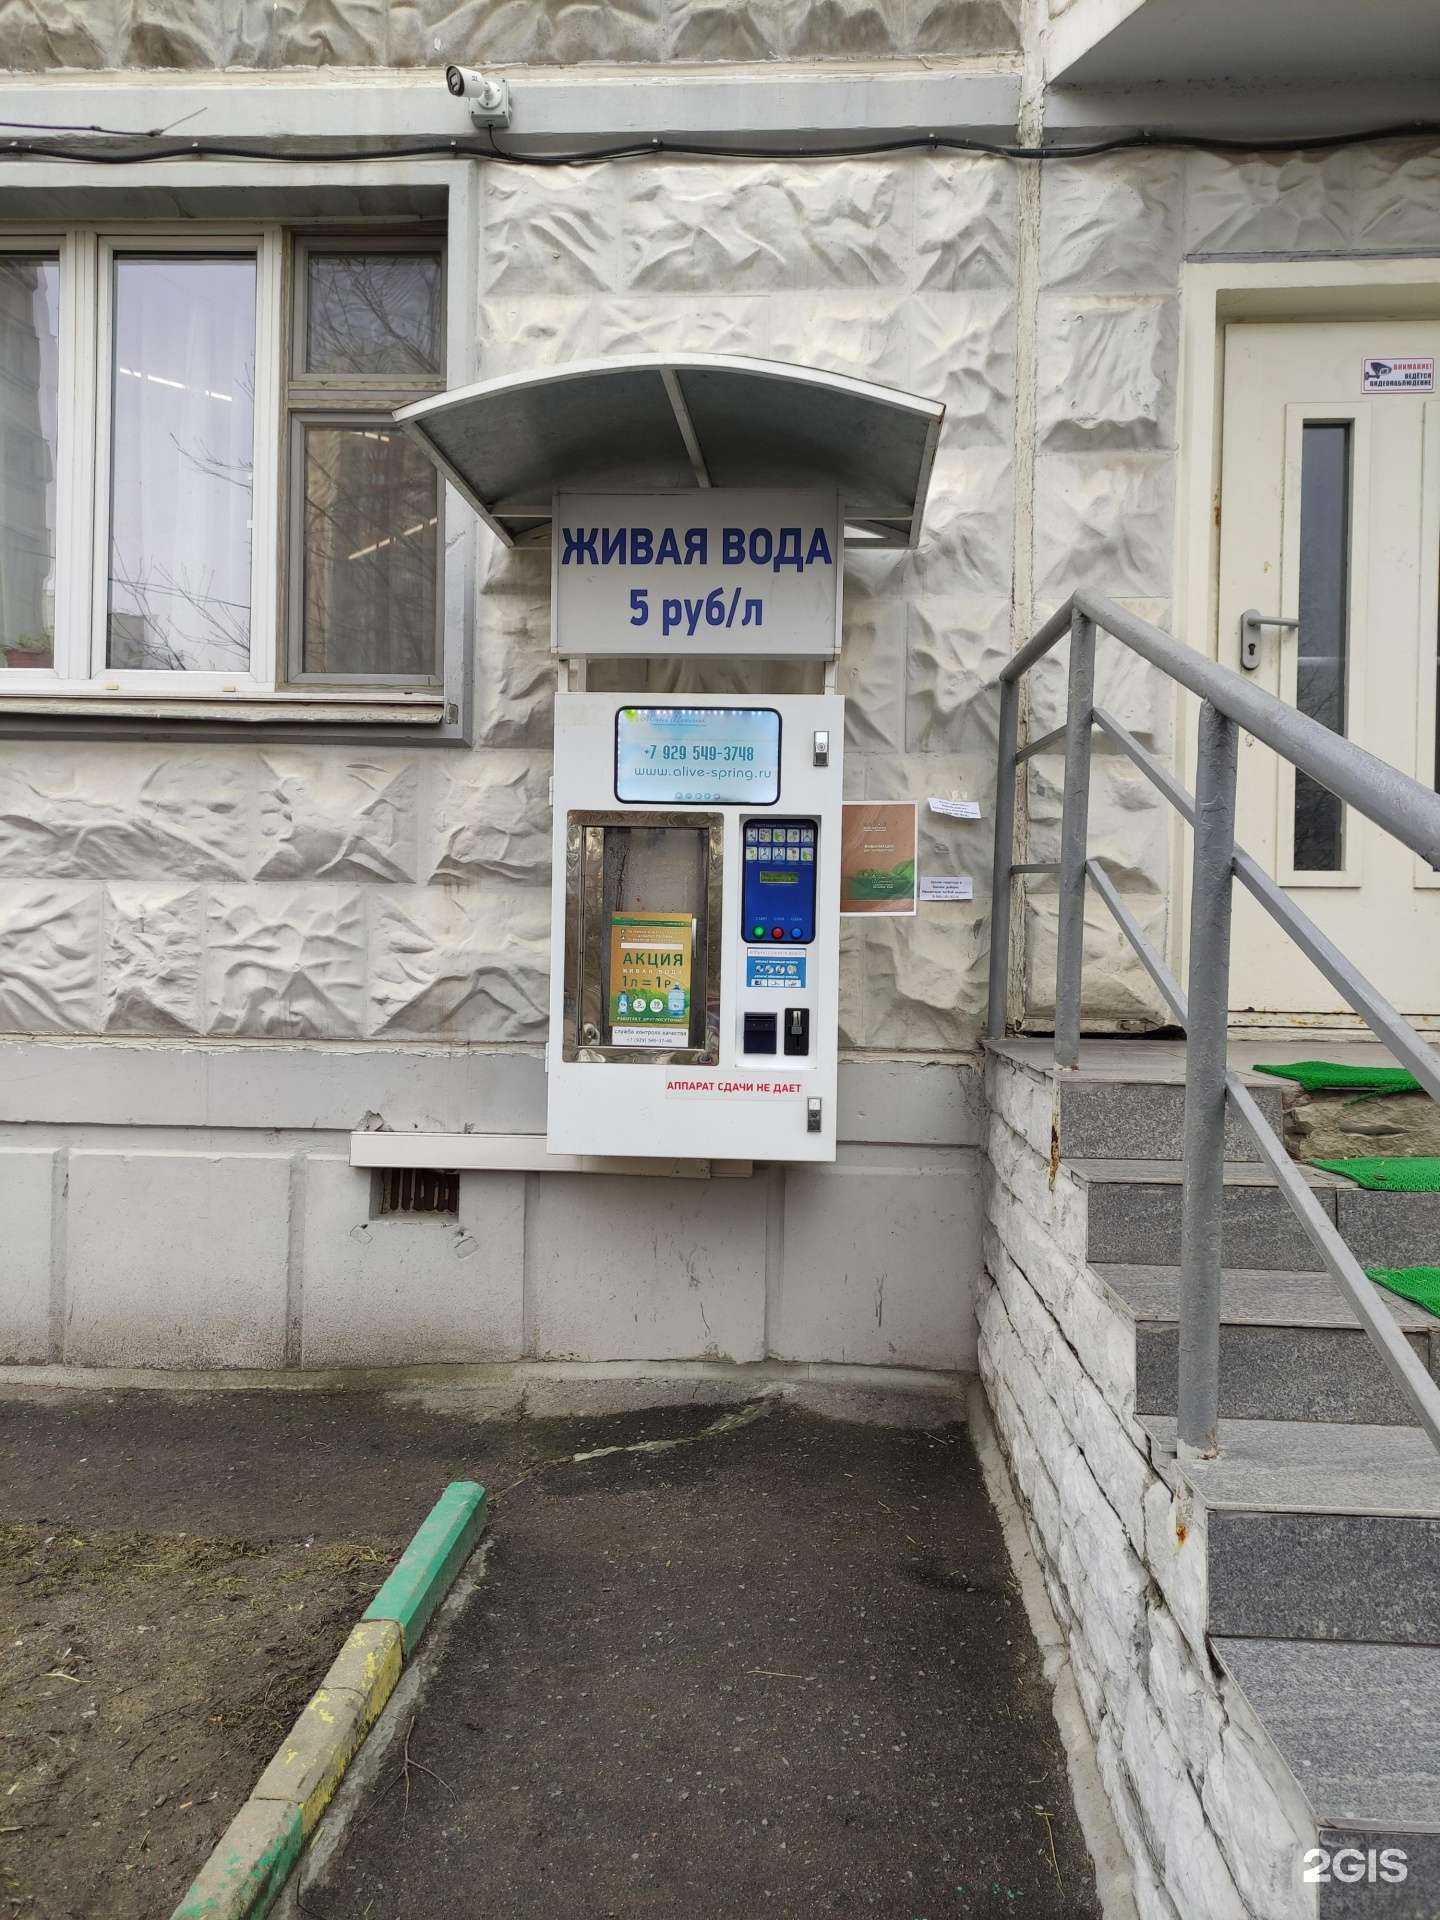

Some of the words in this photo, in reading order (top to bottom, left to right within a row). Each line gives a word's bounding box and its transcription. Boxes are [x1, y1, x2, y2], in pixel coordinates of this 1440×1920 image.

[561, 527, 708, 565] ЖИВАЯ
[722, 527, 832, 573] ВОДА
[630, 589, 649, 626] 5
[662, 586, 763, 637] руб/л
[644, 744, 657, 760] +7
[663, 744, 687, 760] 929
[693, 745, 754, 761] 549-3748
[634, 766, 772, 781] www.alive-spring.ru
[623, 952, 683, 968] АКЦИЯ
[666, 1081, 714, 1091] АППАРАТ
[717, 1082, 753, 1092] СДАЧИ
[756, 1083, 770, 1092] НЕ
[773, 1084, 801, 1093] ДАЕТ
